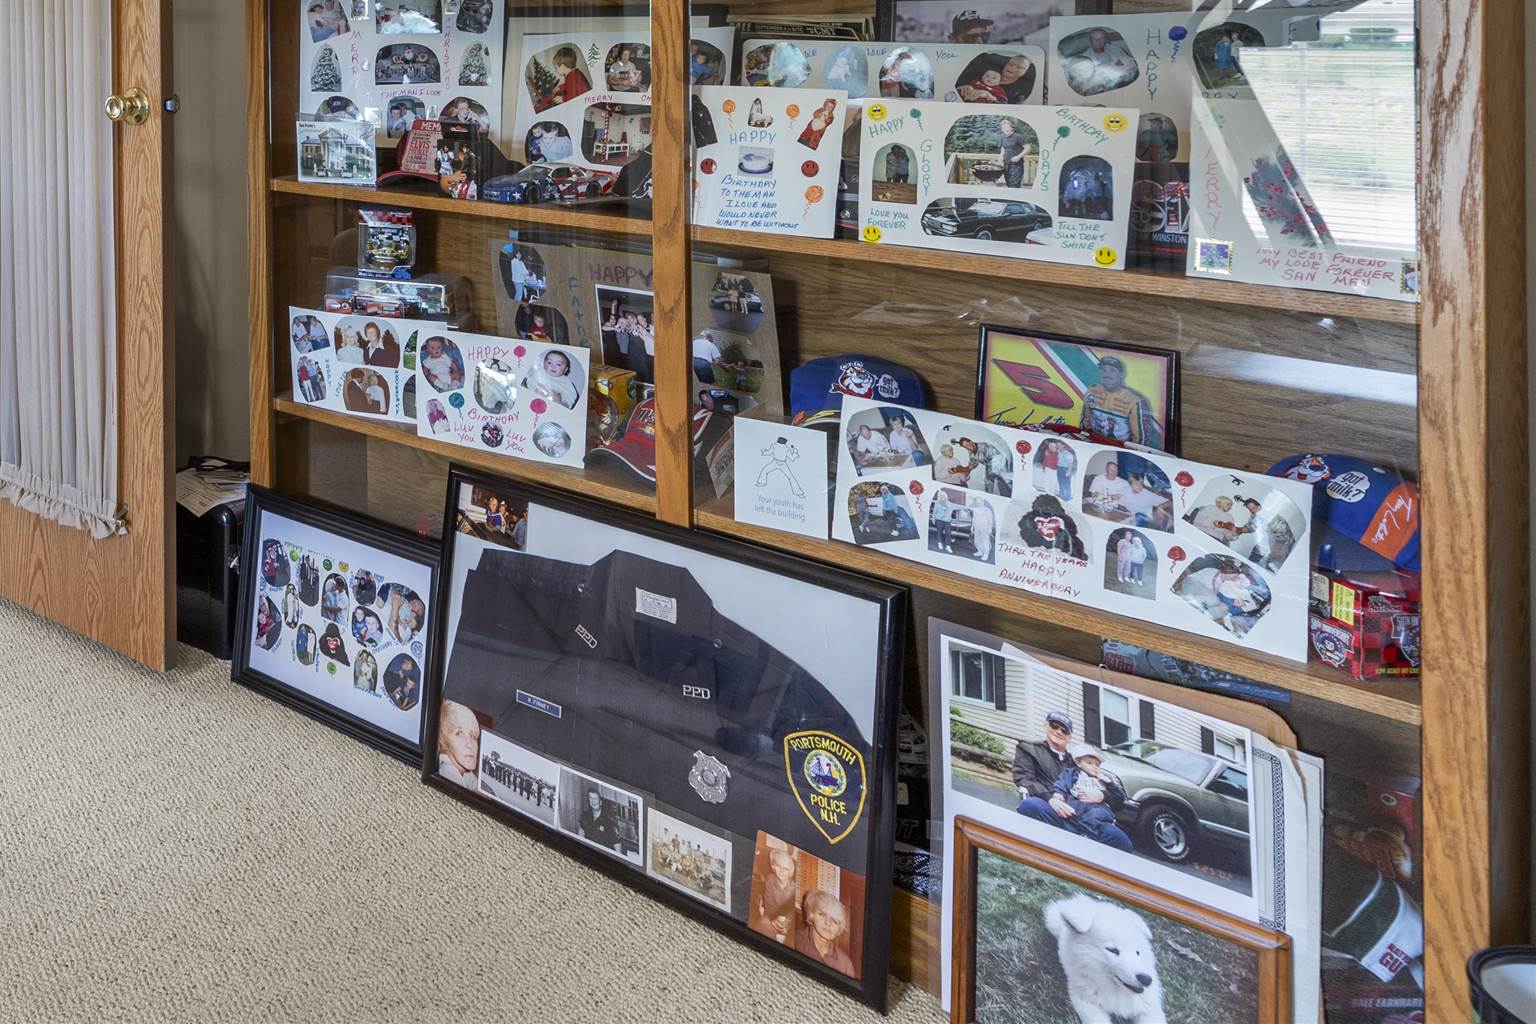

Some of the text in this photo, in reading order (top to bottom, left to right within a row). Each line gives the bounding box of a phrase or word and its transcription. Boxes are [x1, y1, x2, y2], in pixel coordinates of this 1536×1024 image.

[1146, 28, 1161, 101] HAPPY
[868, 116, 905, 139] HAPPY
[1055, 107, 1110, 145] BIRTHDAY
[411, 140, 431, 149] ELVIS
[729, 131, 776, 144] HAPPY
[721, 174, 776, 189] BIRTHDAY
[721, 188, 776, 199] TO THE MAN
[719, 210, 746, 218] WOULD
[892, 211, 909, 220] YOU
[867, 218, 906, 229] FOREVER
[1058, 222, 1101, 232] TILL THE
[1055, 231, 1076, 241] SUN
[1152, 233, 1187, 245] WINSTON
[1061, 240, 1095, 250] SHINE
[1287, 248, 1387, 267] BEST FRIEND
[1326, 265, 1395, 281] FOREVER
[468, 346, 510, 359] HAPPY
[879, 384, 900, 398] milk?
[993, 358, 1075, 410] 5
[467, 408, 520, 425] BIRTHDAY
[506, 430, 527, 442] LUV
[1343, 470, 1363, 485] got
[1326, 481, 1365, 500] milk?
[757, 493, 805, 510] Your youth has
[754, 503, 765, 513] left
[766, 506, 777, 516] the
[1021, 559, 1066, 578] HAPPY
[1055, 556, 1088, 568] YEARS
[575, 624, 598, 649] PPD
[683, 684, 711, 700] PPD
[790, 737, 857, 766] PORTSMOUTH
[810, 793, 847, 815] POLICE
[820, 809, 841, 826] N.H.
